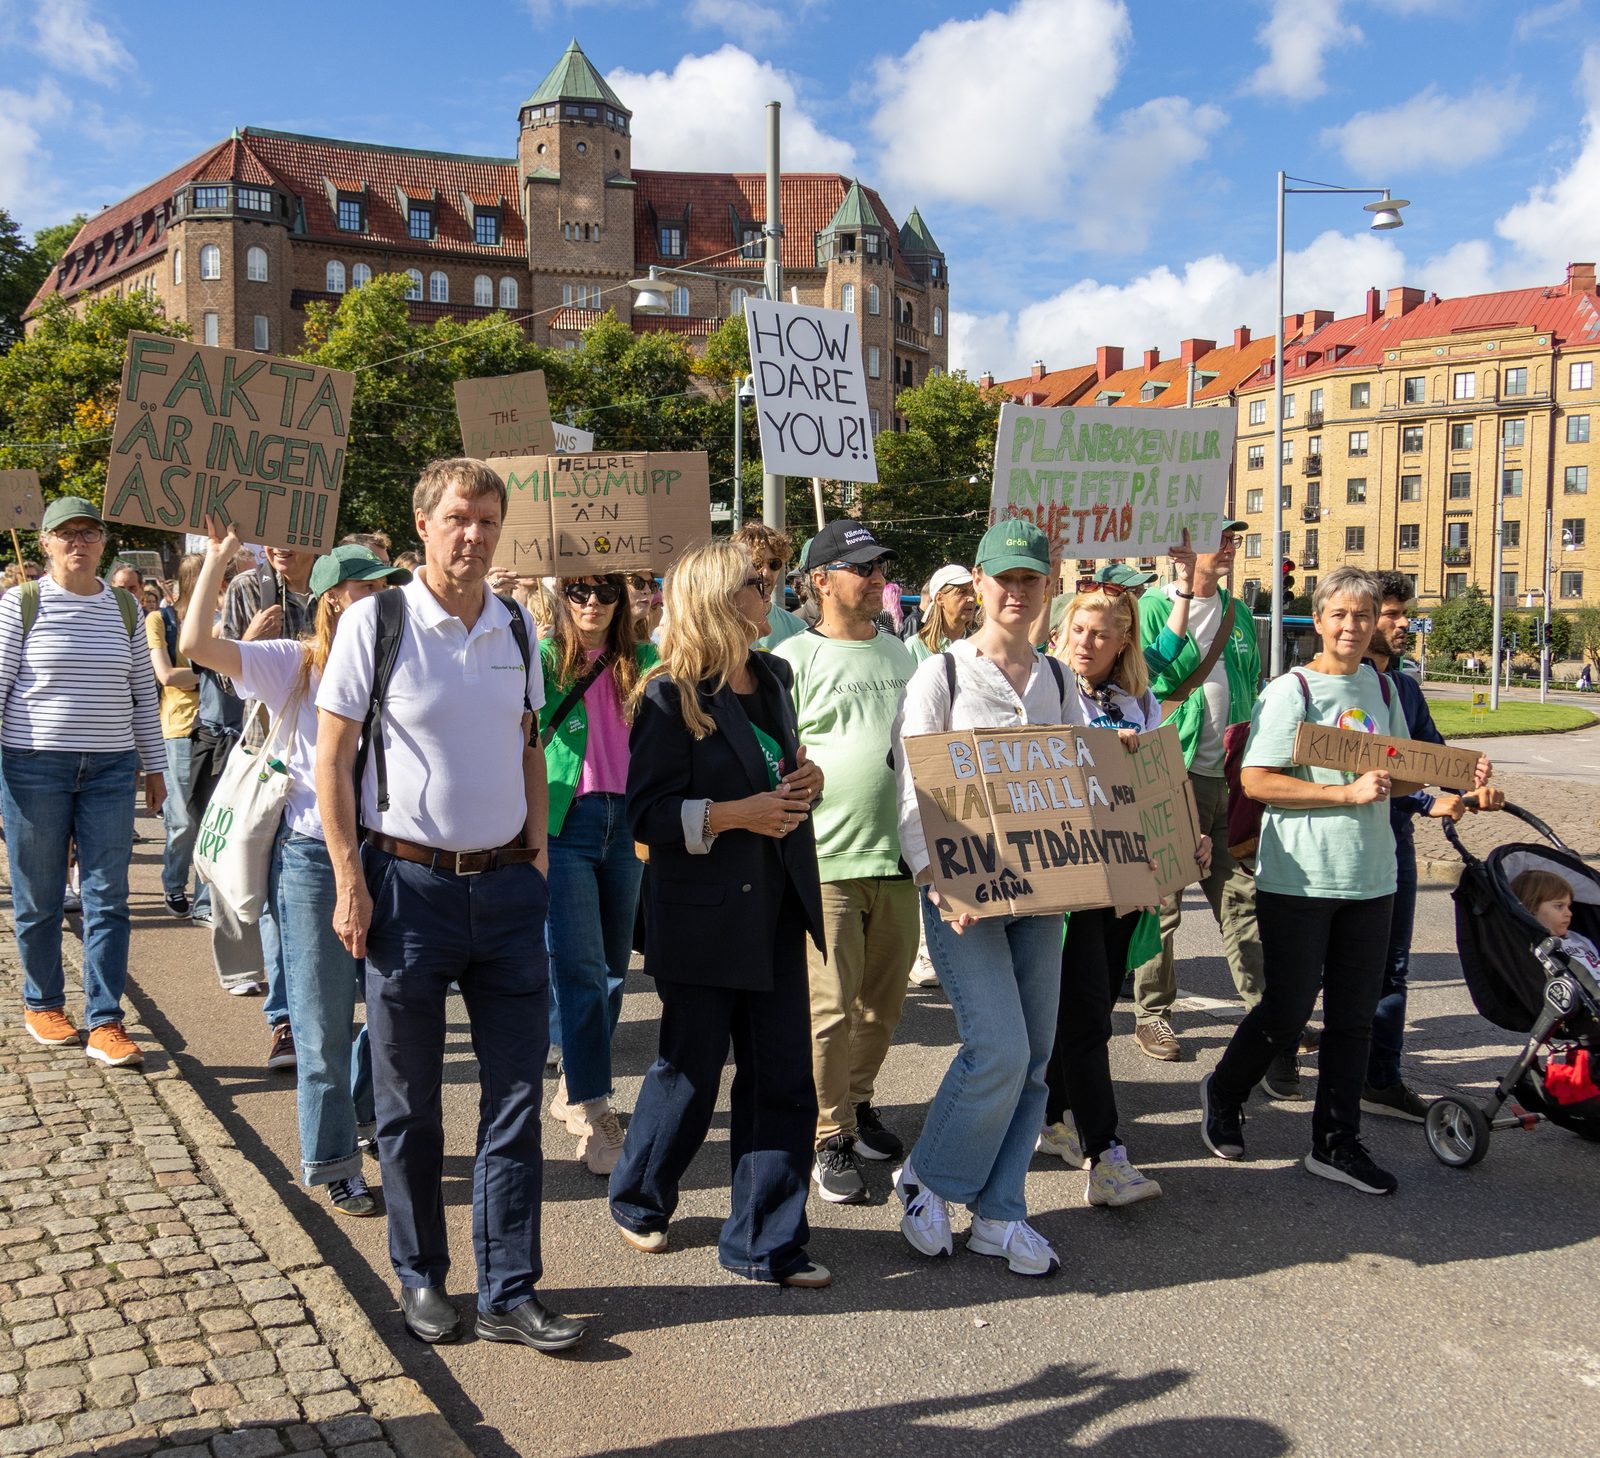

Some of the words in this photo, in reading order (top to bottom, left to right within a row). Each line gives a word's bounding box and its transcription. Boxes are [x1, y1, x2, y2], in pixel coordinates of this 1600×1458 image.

[752, 310, 850, 362] HOW
[126, 336, 346, 438] FAKTA
[473, 375, 538, 411] MAKE
[759, 361, 857, 405] DARE
[488, 408, 520, 426] THE
[763, 411, 868, 460] YOU?!
[116, 401, 192, 466] ÄR
[205, 422, 345, 491] INGEN
[469, 420, 546, 454] PLANET
[1011, 410, 1178, 466] PLÅNBOKEN
[1178, 430, 1221, 463] BLIR
[557, 456, 635, 472] HELLRE
[109, 452, 329, 548] ÅSIKT!!!
[506, 468, 682, 502] MILJÖMUPP
[1007, 468, 1077, 507] INTE
[1079, 470, 1132, 507] FET
[1130, 466, 1161, 507] PÅ
[1166, 473, 1203, 508] EN
[570, 502, 619, 522] ÄN
[1137, 510, 1218, 545] PLANET
[513, 531, 675, 565] MILJÖMES
[1005, 537, 1028, 547] Grön
[832, 681, 872, 695] ACQUA
[947, 736, 1097, 780] BEVARA
[1138, 799, 1176, 842] INTE
[934, 831, 997, 880] RIV
[1005, 820, 1149, 873] TIDÖAVTALET
[975, 878, 1034, 904] GÄRNA
